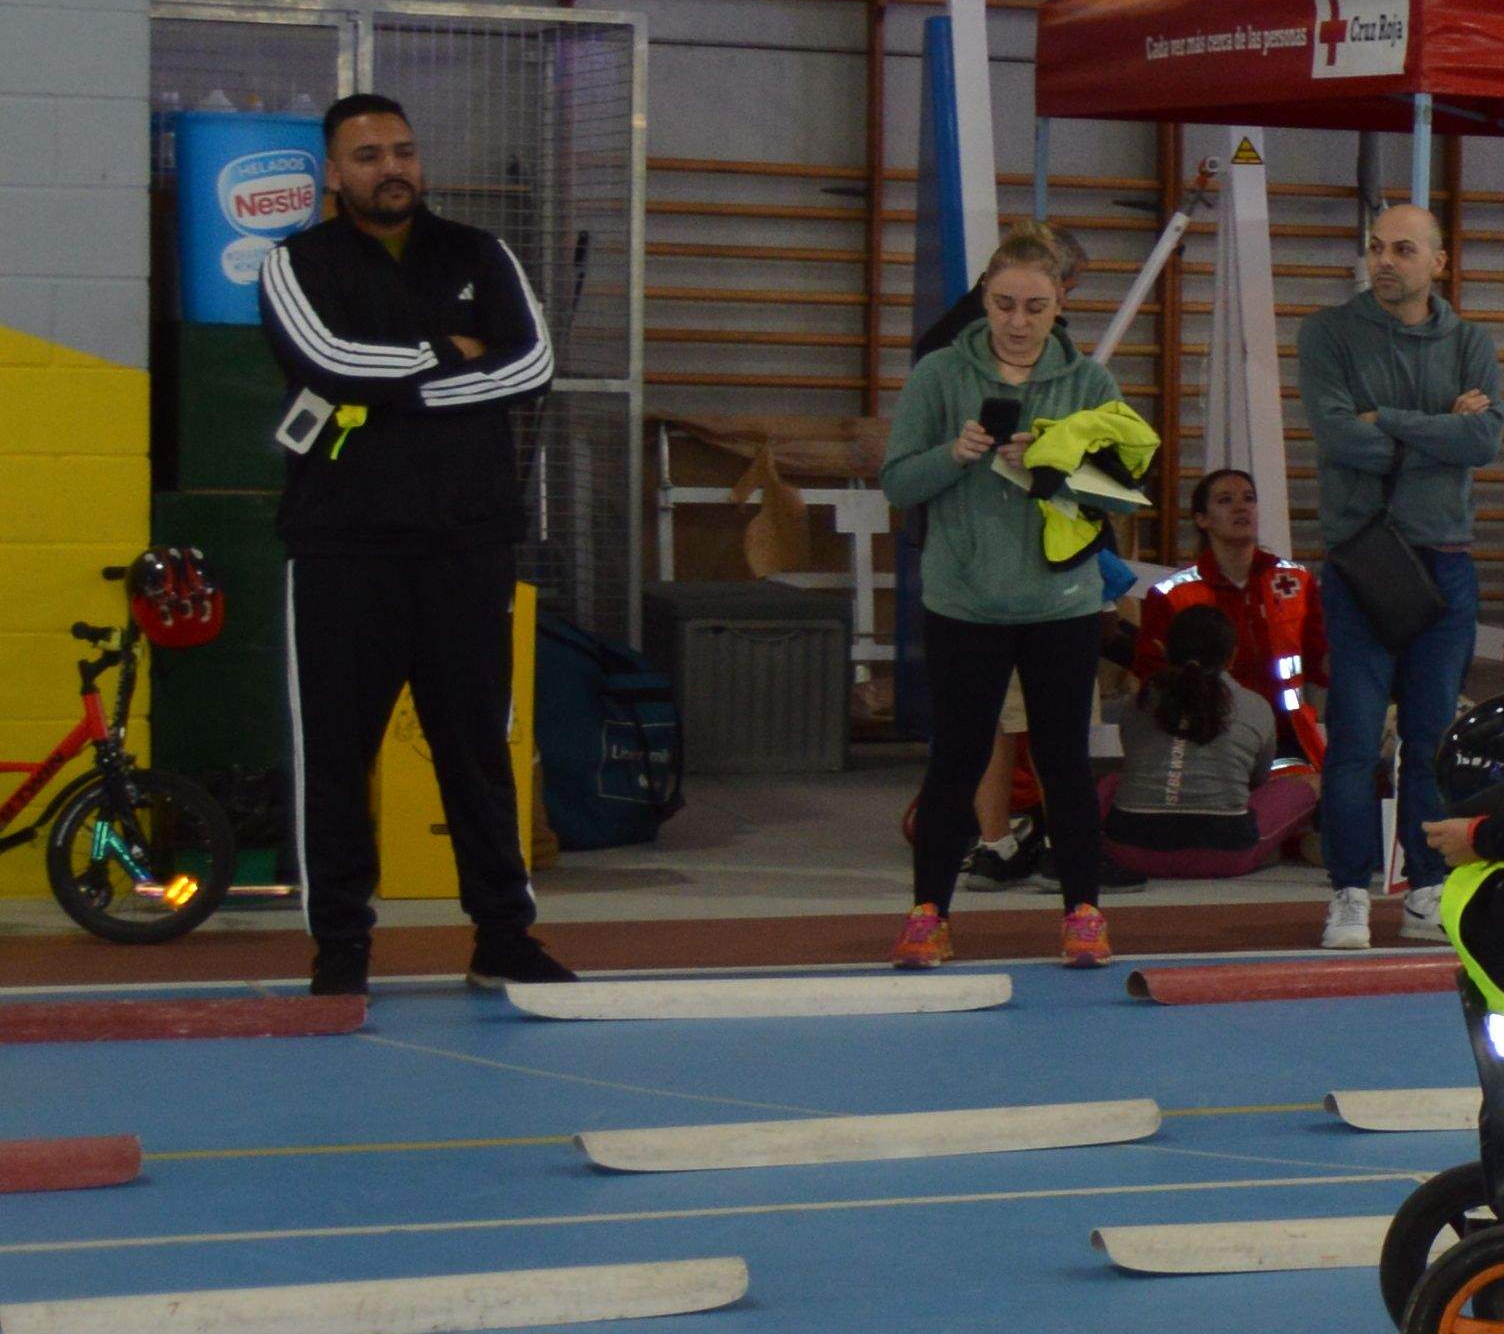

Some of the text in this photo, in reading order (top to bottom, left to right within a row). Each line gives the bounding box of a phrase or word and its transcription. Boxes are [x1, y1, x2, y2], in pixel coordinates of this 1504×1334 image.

[1146, 24, 1308, 60] Cada vez más cerca de las personas
[1350, 14, 1403, 47] Cruz Roja
